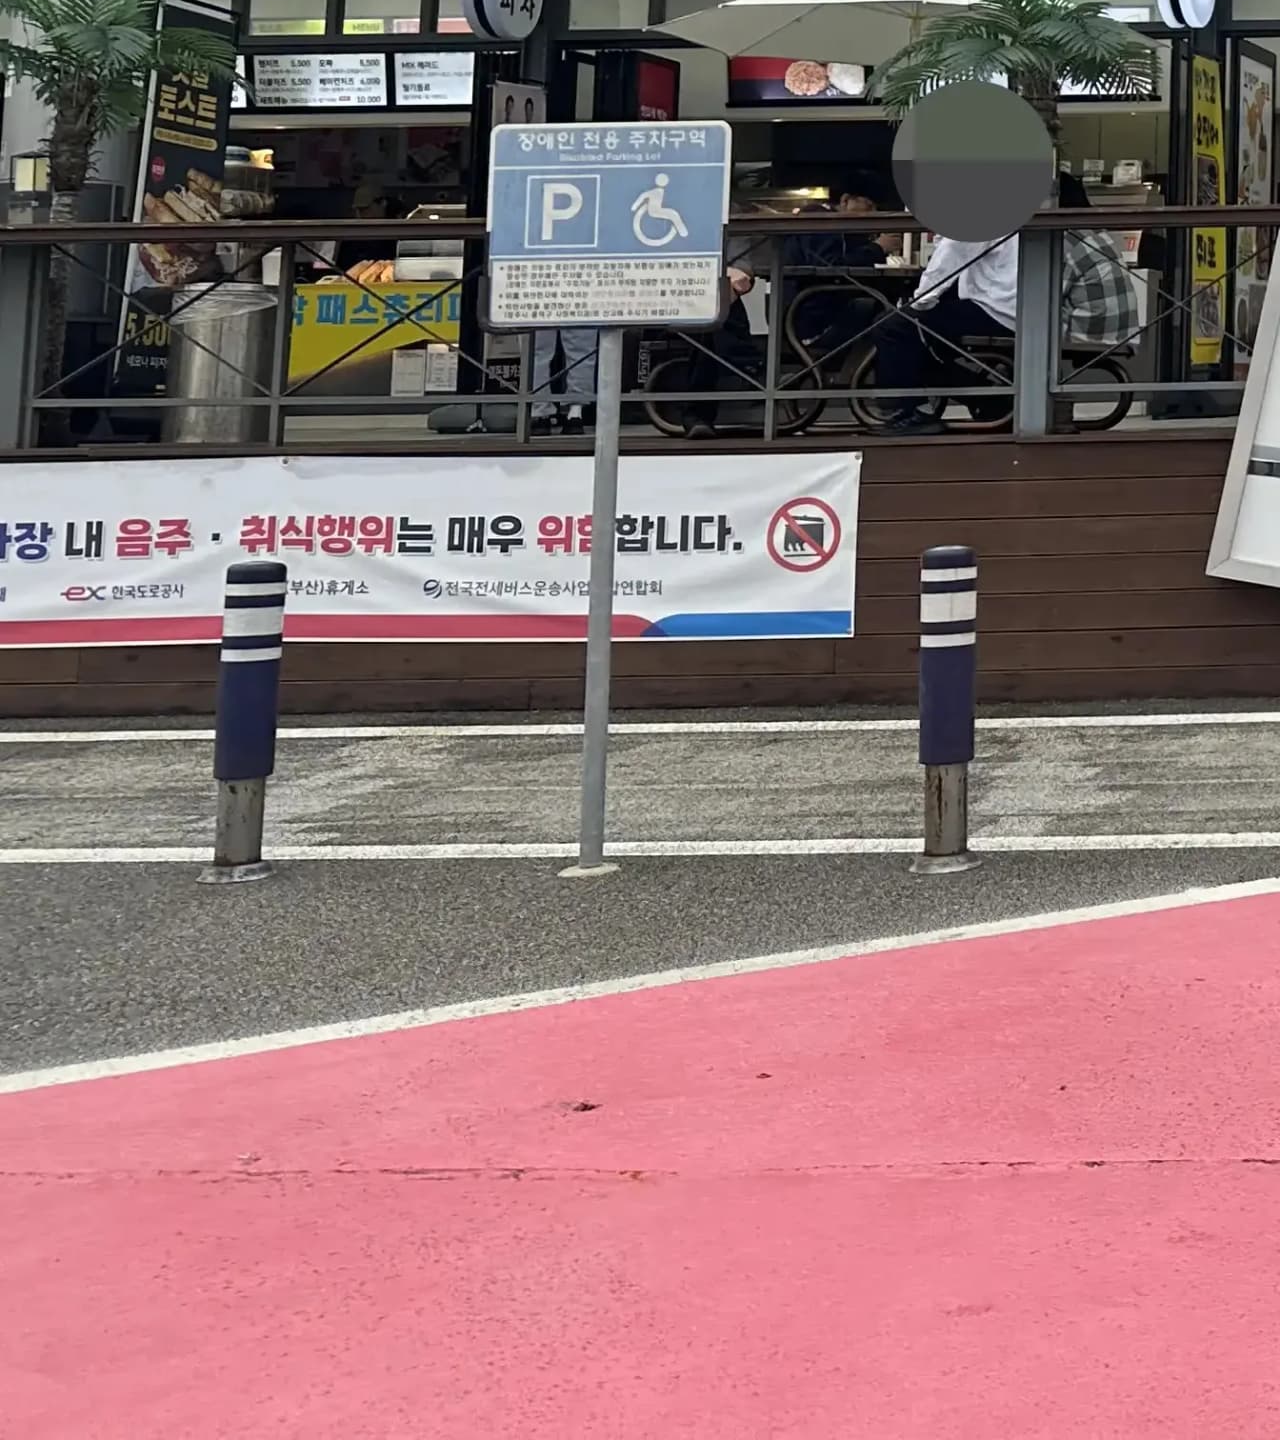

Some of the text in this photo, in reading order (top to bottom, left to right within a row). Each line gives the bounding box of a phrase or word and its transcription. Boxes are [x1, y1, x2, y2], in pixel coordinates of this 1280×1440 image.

[157, 84, 217, 131] 토스트
[517, 129, 706, 152] 장애인 전용 주차구역
[541, 183, 583, 241] P
[125, 312, 170, 346] 5,50
[0, 521, 53, 560] 장
[65, 520, 103, 559] 내
[115, 518, 192, 558] 음주
[239, 515, 433, 556] 취식행위는
[446, 515, 524, 554] 매우
[60, 585, 106, 602] ex
[112, 583, 185, 601] 한국도로공사
